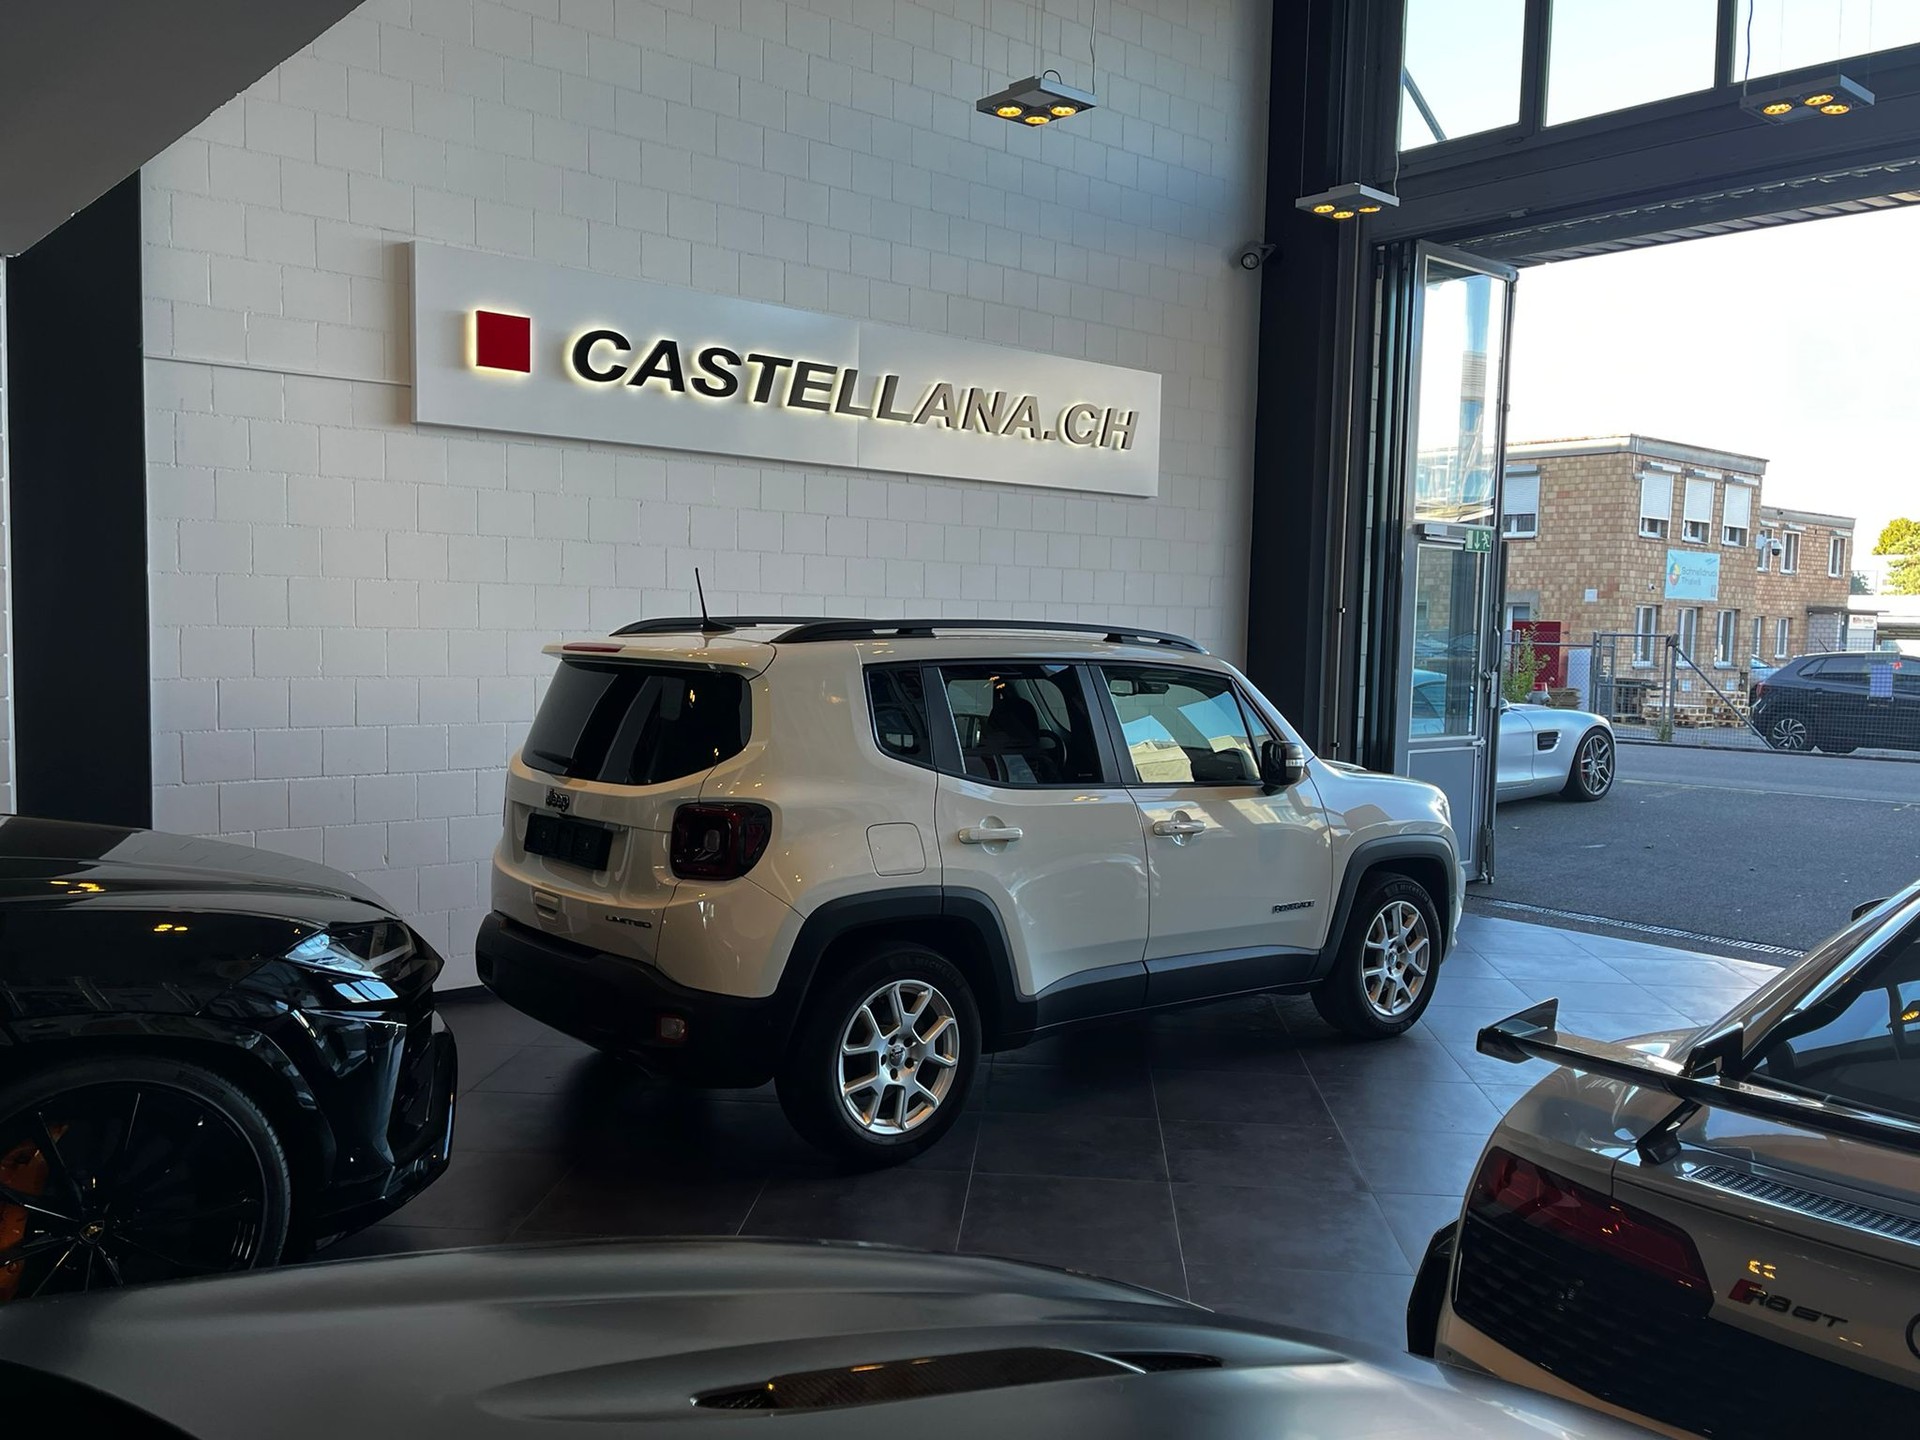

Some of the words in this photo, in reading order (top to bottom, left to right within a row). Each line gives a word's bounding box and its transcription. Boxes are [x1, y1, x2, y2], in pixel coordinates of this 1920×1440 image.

[571, 329, 1139, 450] CASTELLANA.CH
[546, 788, 570, 812] Jeep
[605, 915, 652, 928] LIMITED
[1734, 1280, 1791, 1313] R8
